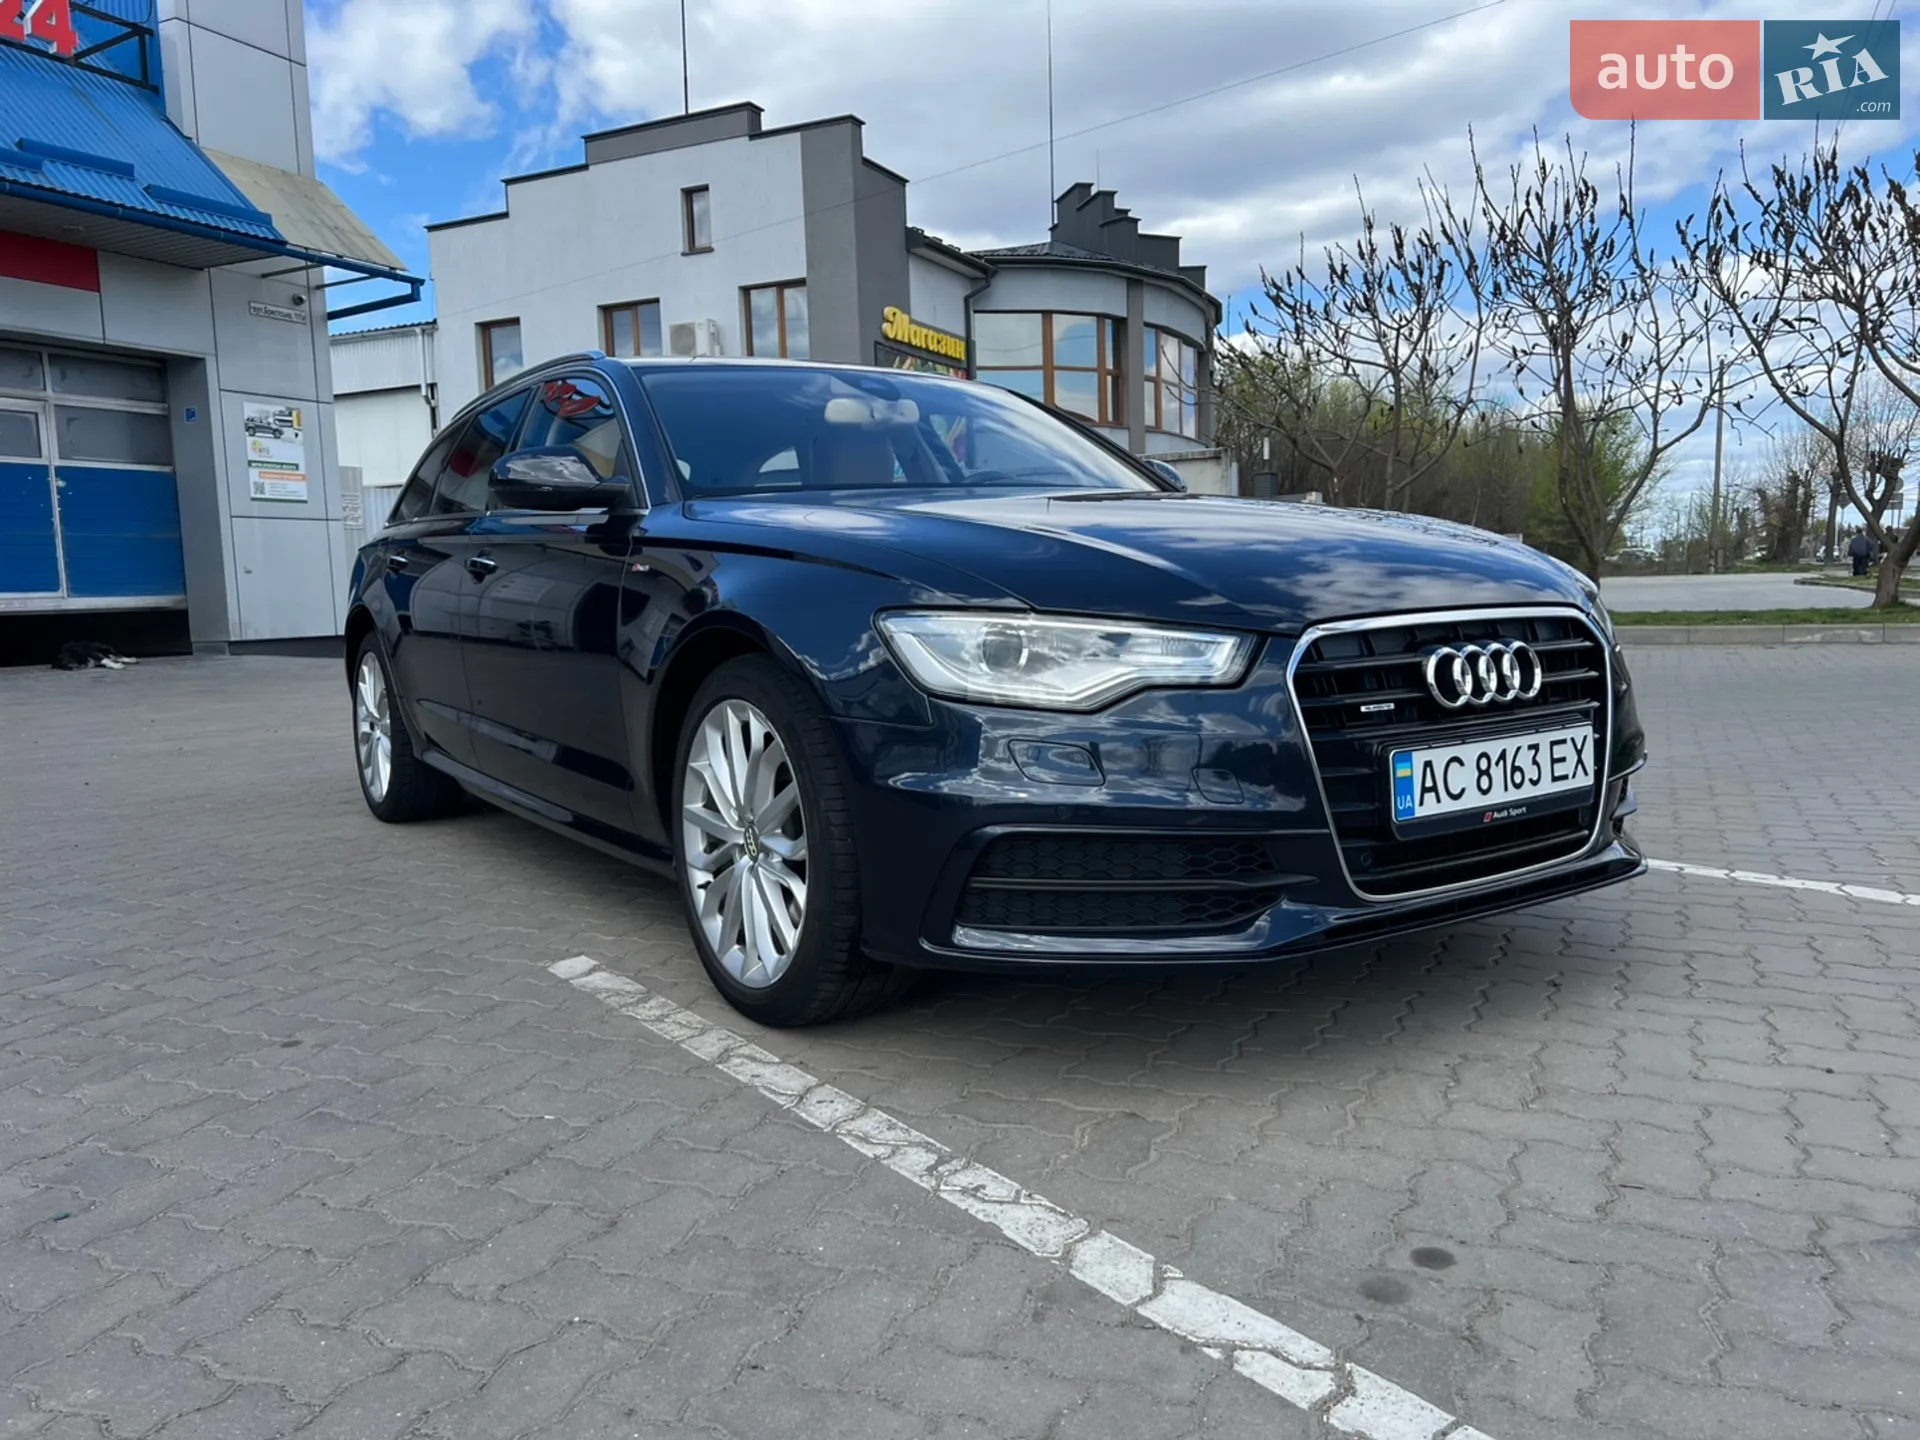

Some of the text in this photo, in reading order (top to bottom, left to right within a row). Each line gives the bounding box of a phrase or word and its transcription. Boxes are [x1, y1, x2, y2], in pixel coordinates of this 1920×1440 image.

[882, 305, 966, 361] Магазин
[1419, 734, 1589, 807] AC 8163 EX
[1397, 795, 1413, 810] UA
[1493, 806, 1527, 819] Audi Sport
